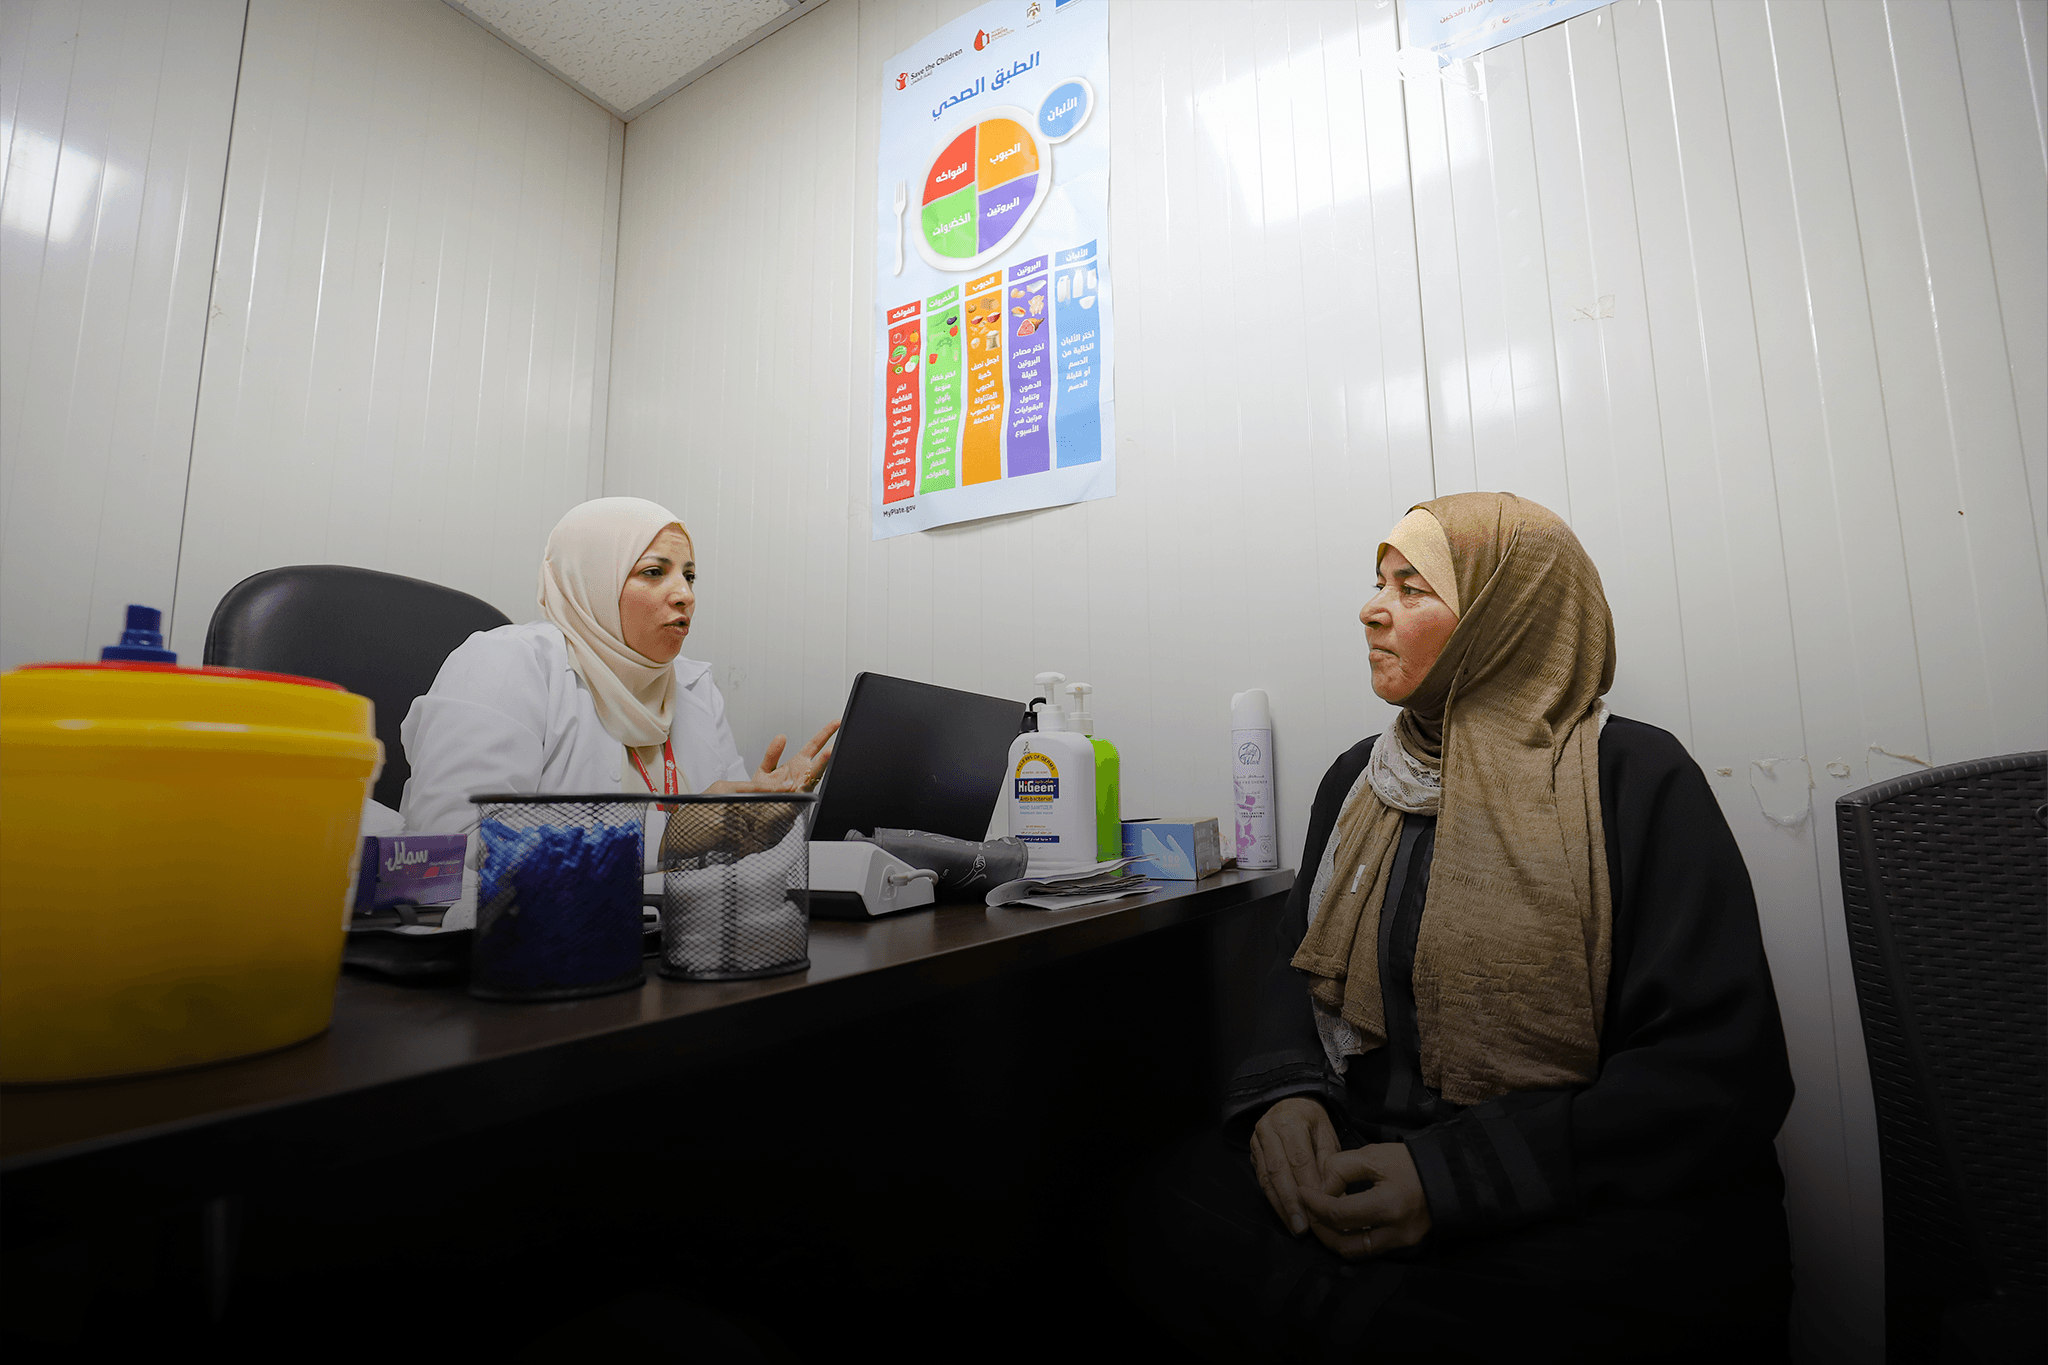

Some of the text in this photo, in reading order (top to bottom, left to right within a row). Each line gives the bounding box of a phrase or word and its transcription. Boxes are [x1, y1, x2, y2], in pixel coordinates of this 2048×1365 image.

[911, 69, 924, 80] Save
[925, 62, 935, 72] the
[936, 48, 963, 66] Children
[931, 50, 1040, 122] الطبق الصحي
[1047, 96, 1078, 122] الألبان
[989, 142, 1021, 164] الحبوب
[935, 162, 968, 183] الفواكه
[986, 196, 1020, 218] البروتين
[932, 212, 971, 237] الخضروات
[1065, 248, 1089, 262] الألبان
[1016, 260, 1042, 277] البروتين
[972, 276, 995, 292] الحبوب
[929, 290, 956, 308] الخضروات
[892, 305, 916, 319] الفواكه
[1061, 333, 1081, 346] الألبان
[1012, 348, 1031, 360] مصادر
[1061, 342, 1094, 358] الخالية من
[970, 361, 984, 371] نصف
[1017, 356, 1041, 369] البروتين
[1068, 356, 1088, 369] الدسم
[1021, 369, 1038, 380] قليلة
[1066, 369, 1082, 380] قليلة
[976, 380, 995, 393] الحبوب
[1019, 380, 1042, 393] الدهون
[1068, 380, 1088, 393] الدسم
[1020, 393, 1040, 404] وتناول
[970, 404, 990, 416] الحبوب
[1014, 402, 1044, 415] البقوليات
[1012, 414, 1043, 428] مرتين في
[1015, 424, 1039, 438] الأسبوع
[882, 504, 916, 518] MyPlate.gov
[1018, 780, 1054, 793] HiGeen
[384, 841, 429, 872] سمايل
[1162, 854, 1180, 864] 100
